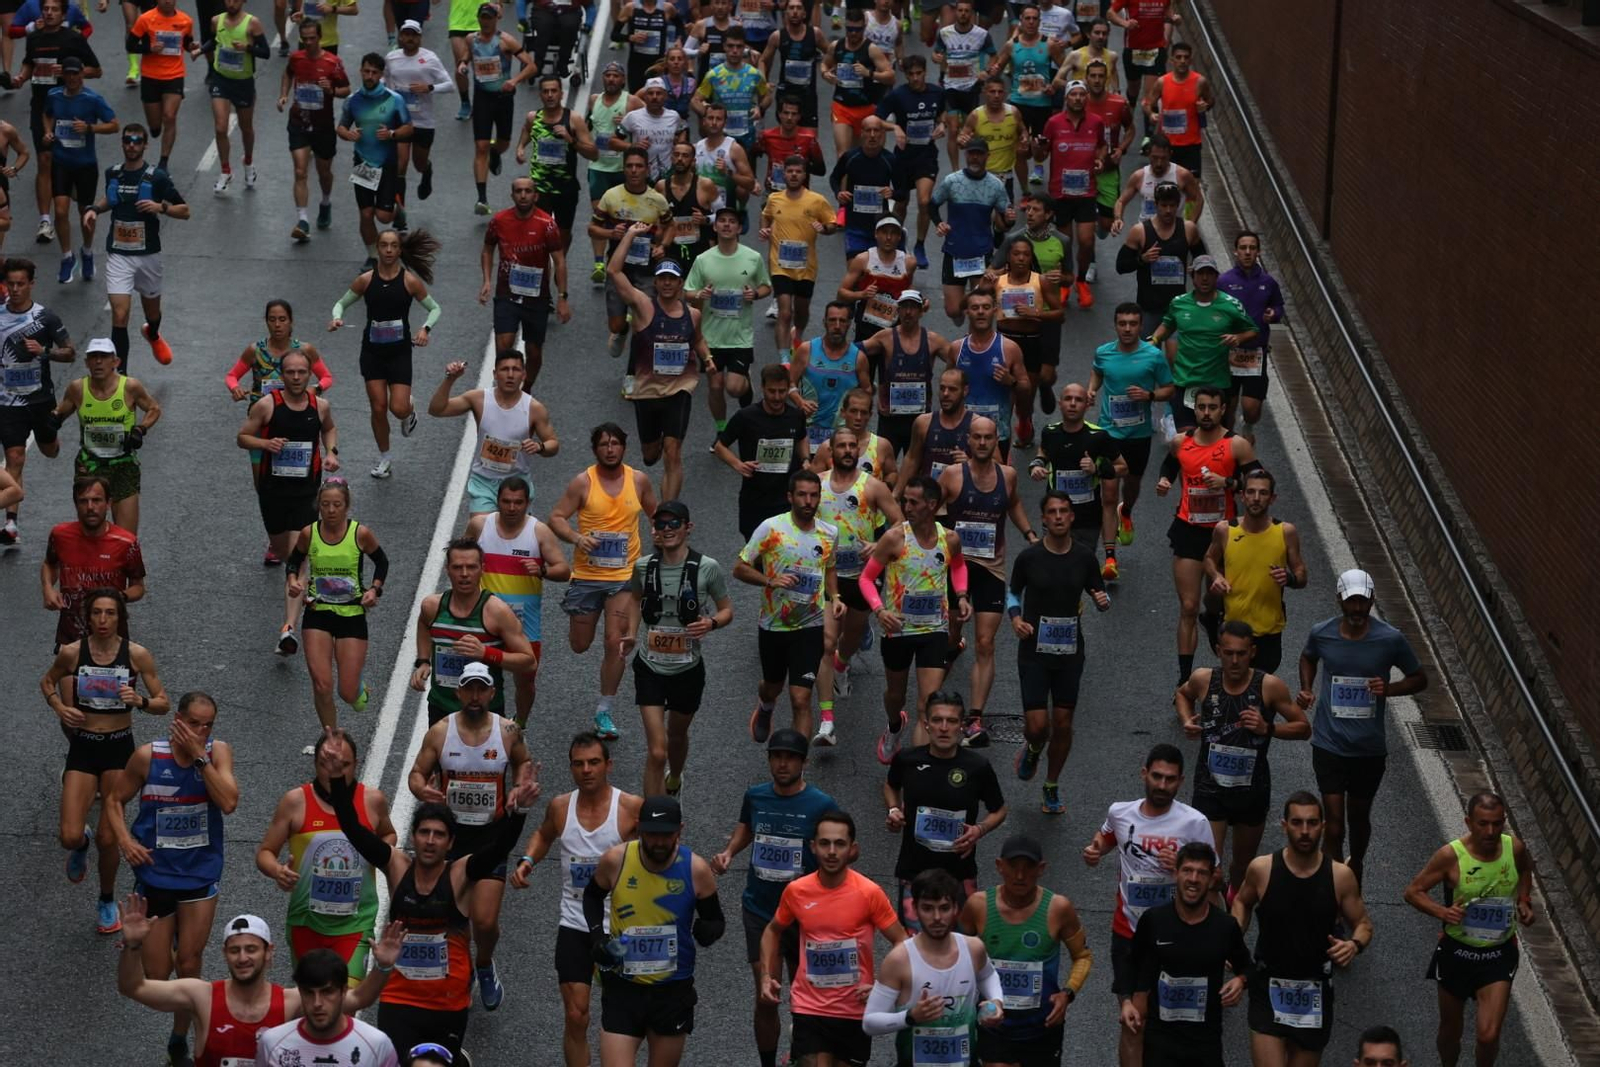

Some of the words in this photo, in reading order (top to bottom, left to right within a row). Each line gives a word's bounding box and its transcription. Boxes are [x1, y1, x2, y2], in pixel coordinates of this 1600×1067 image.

[661, 351, 682, 362] 3011
[10, 370, 32, 381] 2910
[278, 452, 303, 463] 2348
[487, 444, 510, 458] 4247
[1062, 479, 1088, 490] 1655
[962, 532, 987, 544] 1570
[654, 636, 682, 648] 6271
[1338, 688, 1366, 700] 3377
[1216, 755, 1245, 770] 2258
[451, 791, 489, 806] 15636
[166, 817, 197, 830] 2236
[924, 817, 954, 834] 2961
[759, 846, 790, 863] 2260
[318, 880, 351, 895] 2780
[1135, 886, 1167, 900] 2674
[1470, 908, 1503, 923] 3379
[402, 945, 436, 960] 2858
[631, 939, 663, 954] 1677
[813, 952, 845, 967] 2694
[1481, 949, 1503, 960] MAX
[1162, 988, 1194, 1003] 3262
[1279, 992, 1310, 1007] 1939
[922, 1039, 957, 1056] 3261
